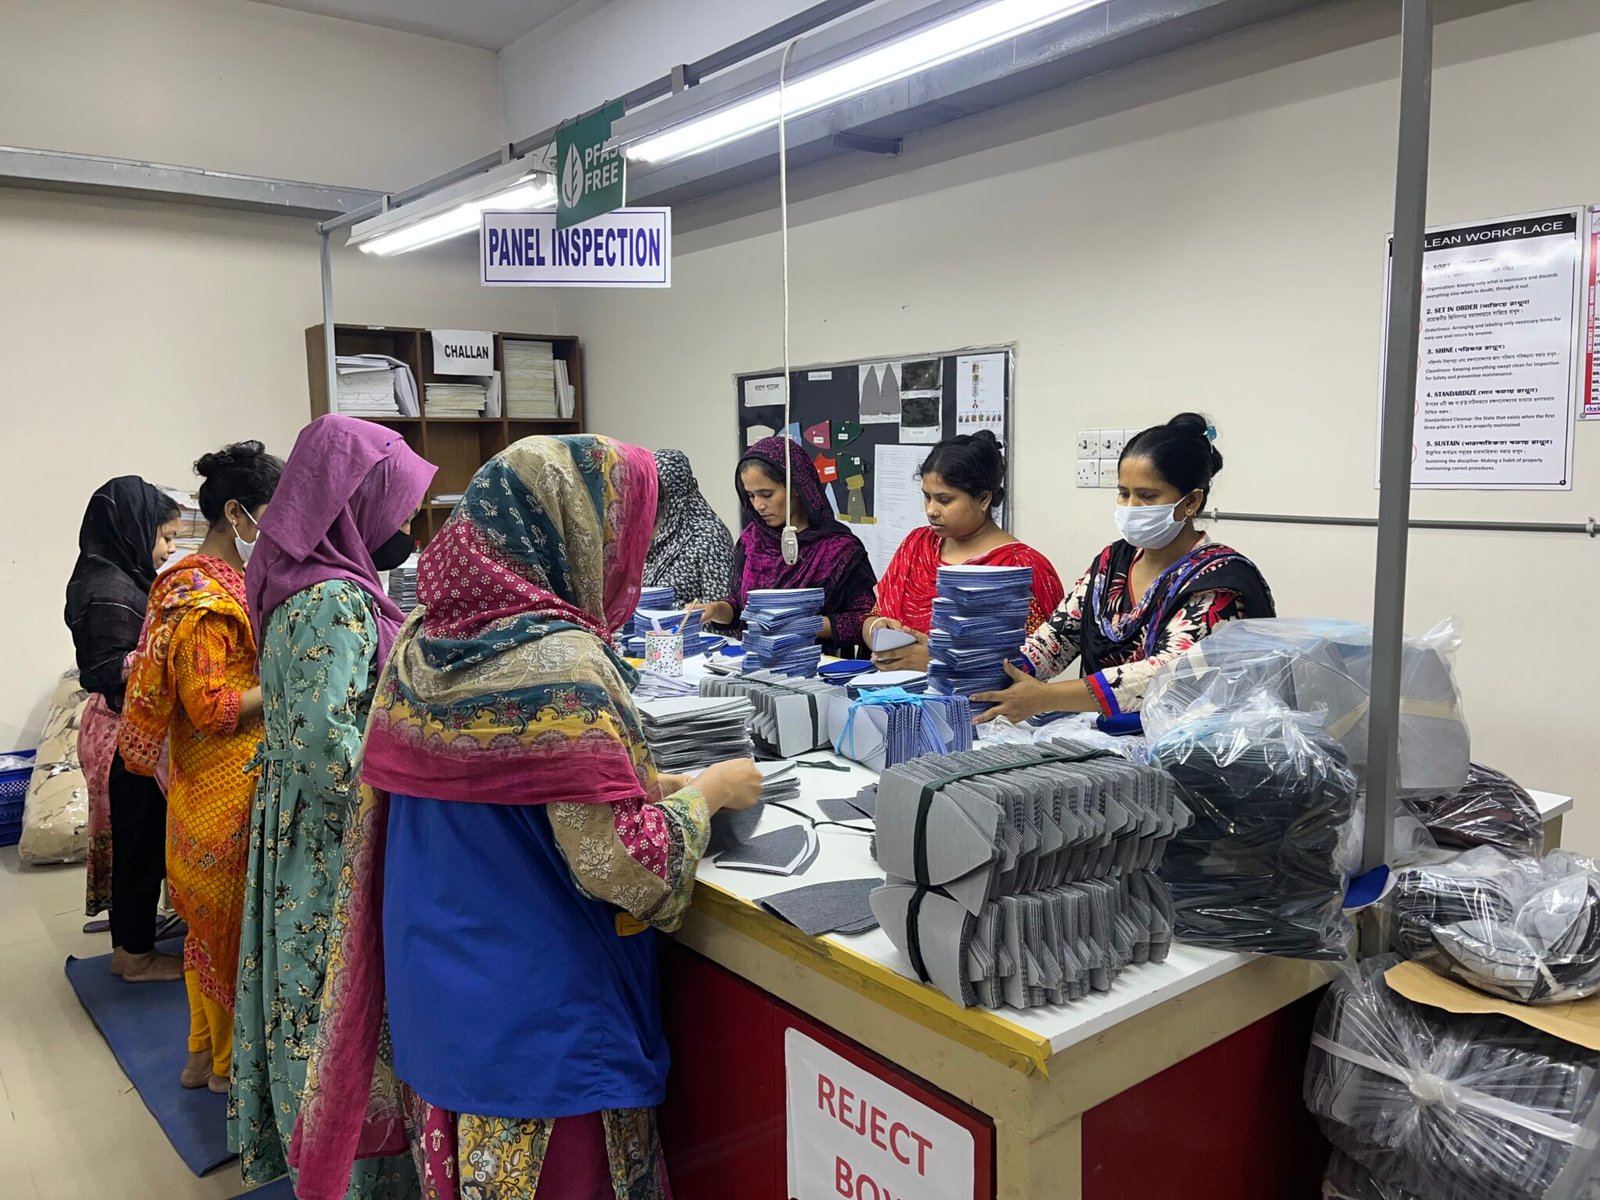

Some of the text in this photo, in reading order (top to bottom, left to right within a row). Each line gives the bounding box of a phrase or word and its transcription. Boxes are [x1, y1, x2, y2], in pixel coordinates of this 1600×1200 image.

[585, 162, 619, 194] FREE
[489, 228, 660, 266] PANEL INSPECTION
[1466, 221, 1563, 242] WORKPLACE
[444, 344, 488, 359] CHALLAN
[818, 1073, 933, 1176] REJECT
